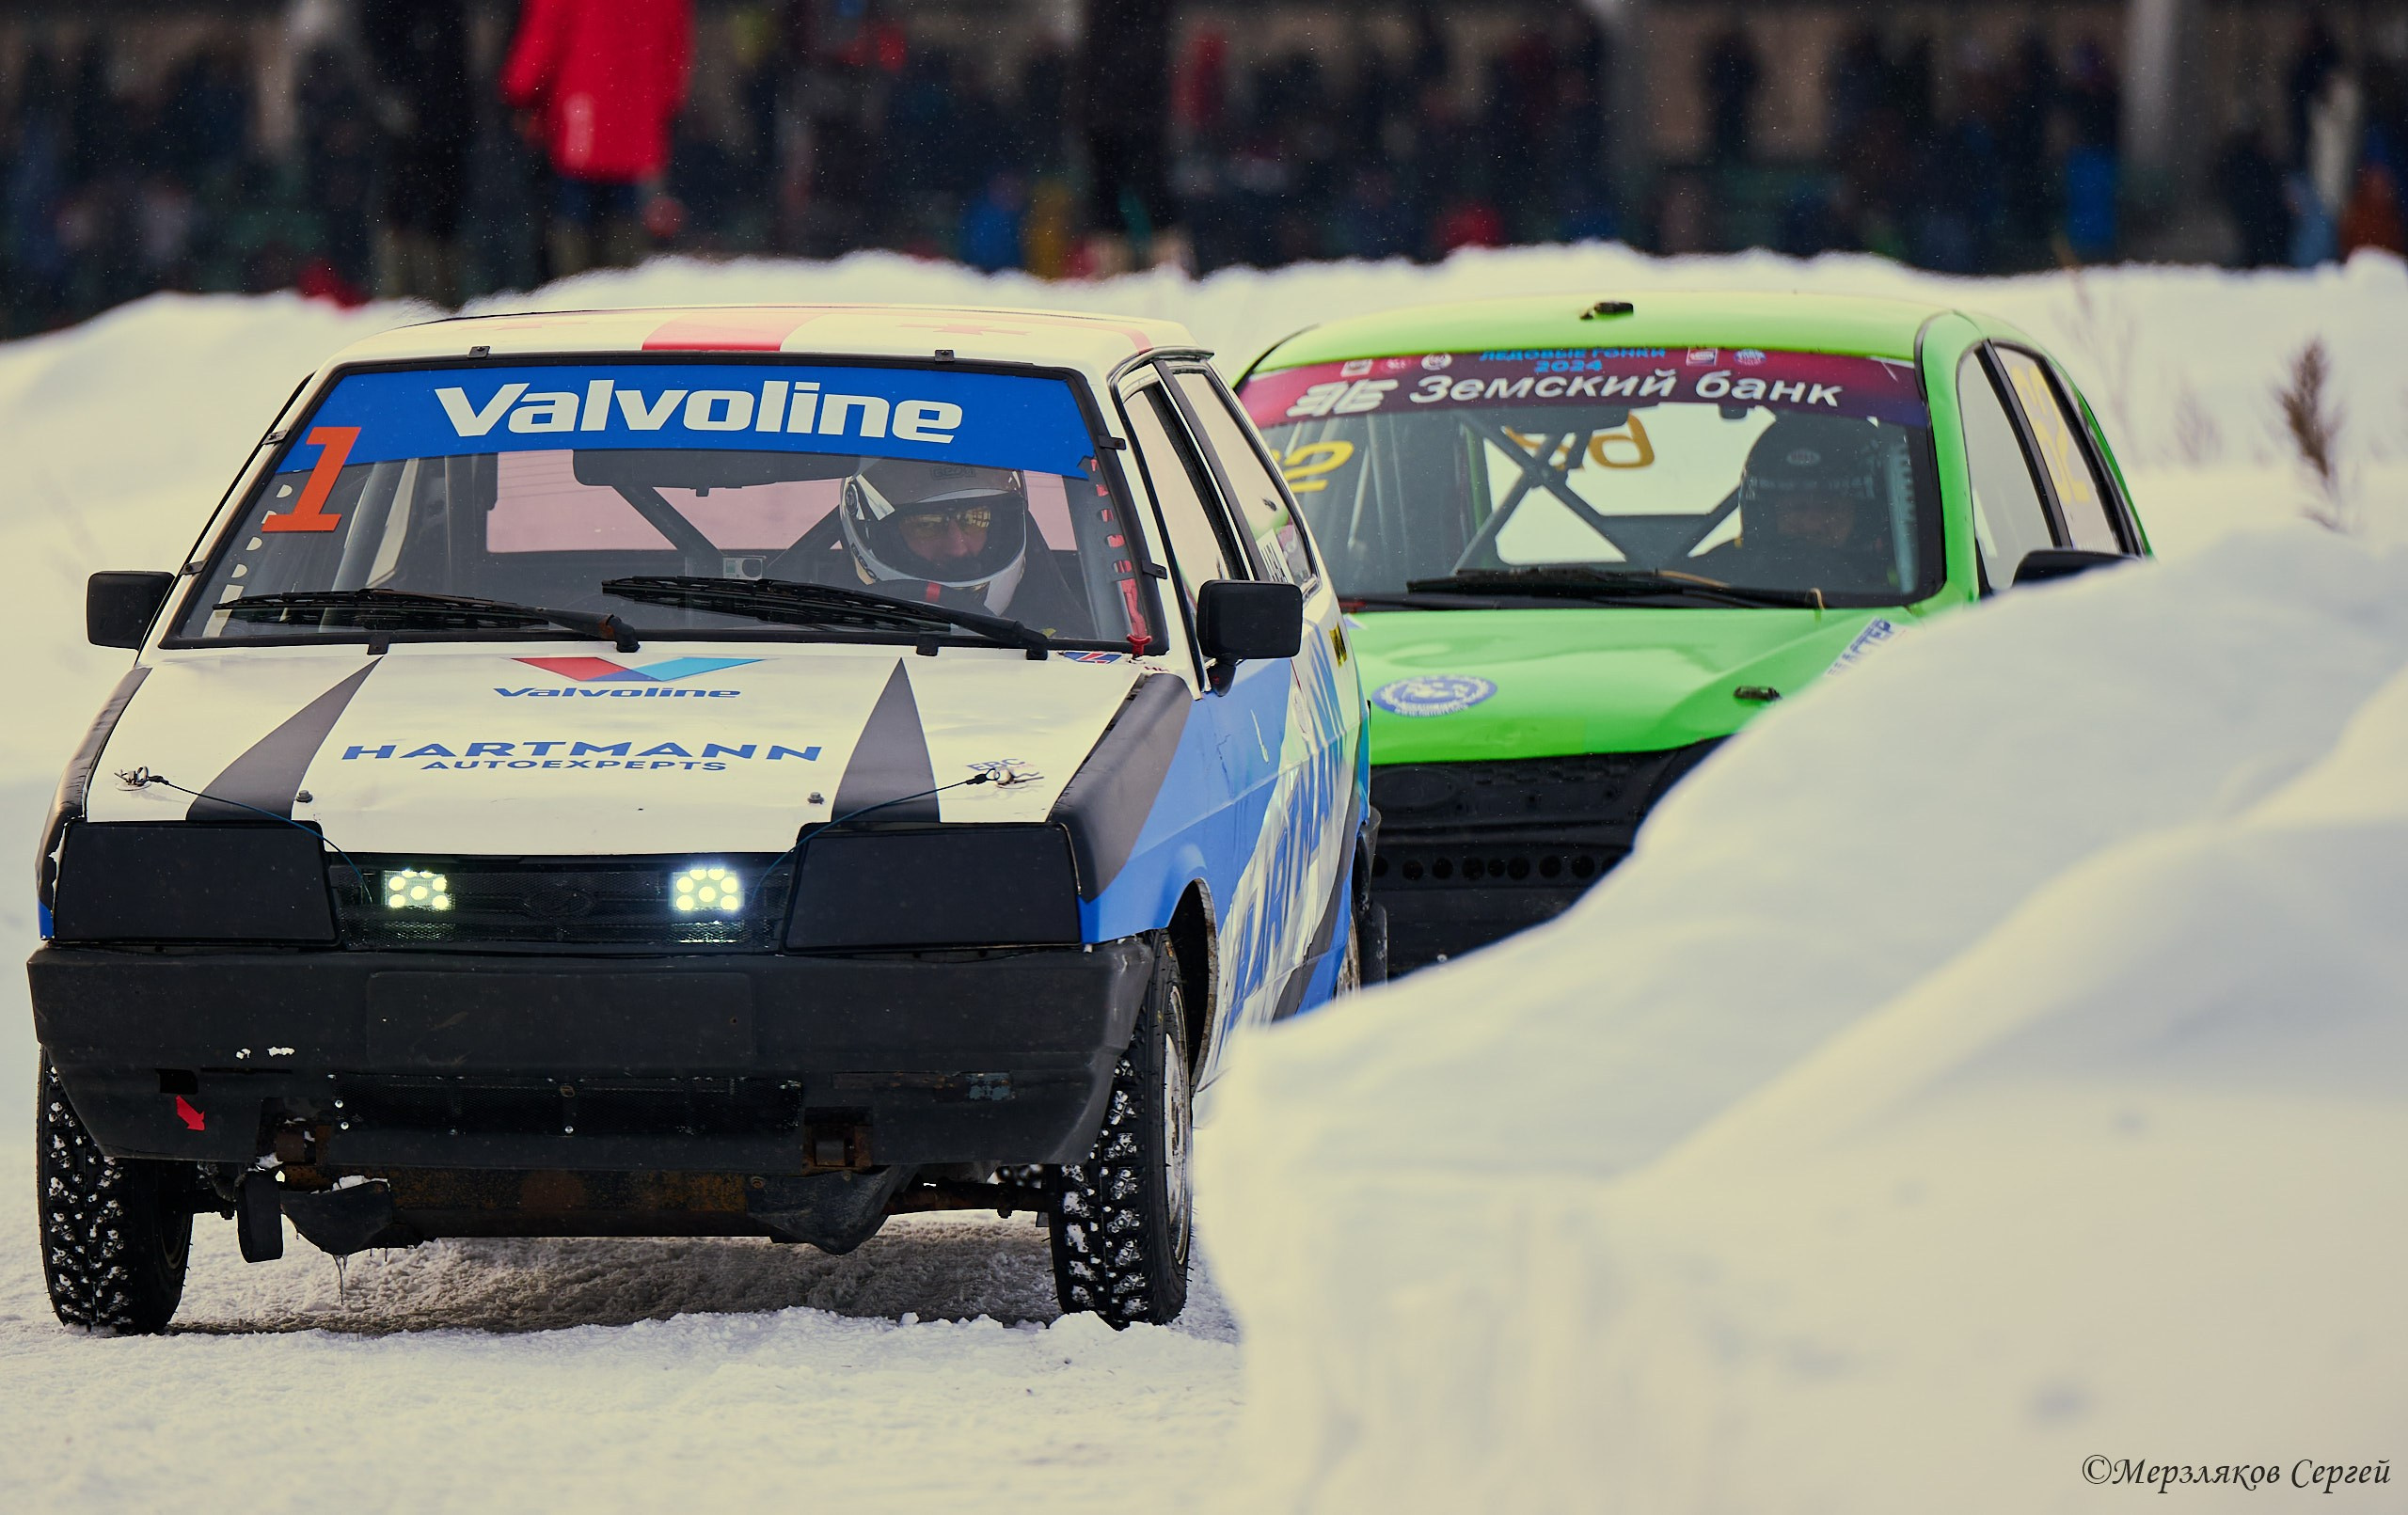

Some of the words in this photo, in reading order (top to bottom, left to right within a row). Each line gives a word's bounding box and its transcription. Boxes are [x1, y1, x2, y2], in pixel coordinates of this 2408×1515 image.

[1479, 348, 1586, 361] ЛЕДОВЫЕ
[1592, 347, 1665, 358] ГОНКИ
[1534, 359, 1603, 373] 2024
[1409, 368, 1677, 403] Земский
[1695, 370, 1843, 408] банк
[435, 379, 963, 446] Valvoline
[261, 426, 362, 532] 1
[1271, 440, 1355, 494] 2
[493, 686, 742, 699] Valvoline
[341, 740, 823, 763] HARTMANN
